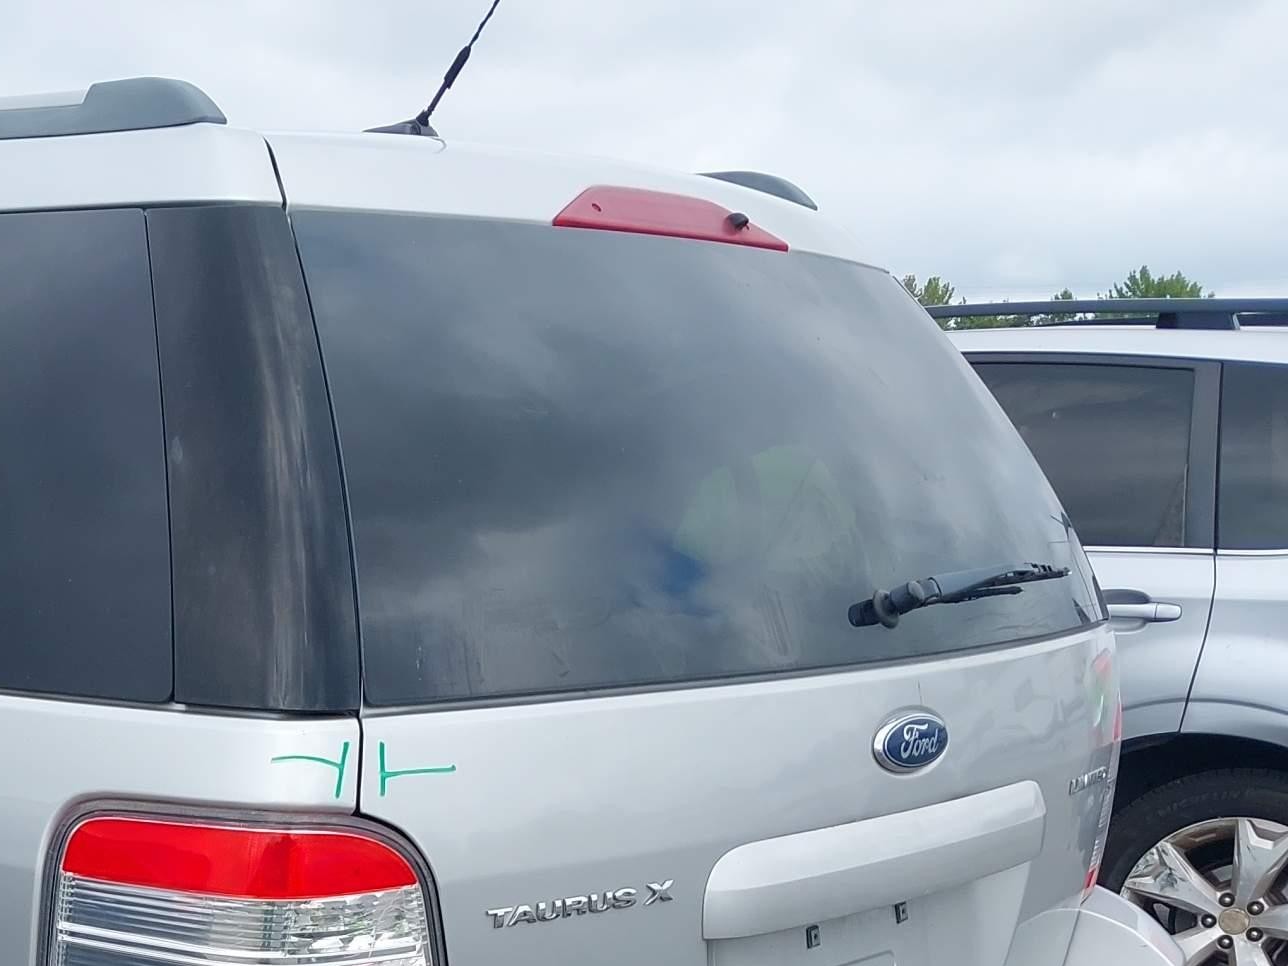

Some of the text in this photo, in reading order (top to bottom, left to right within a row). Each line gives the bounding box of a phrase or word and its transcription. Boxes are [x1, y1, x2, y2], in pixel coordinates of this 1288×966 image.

[900, 722, 939, 759] Ford
[484, 879, 675, 930] TAURUS X
